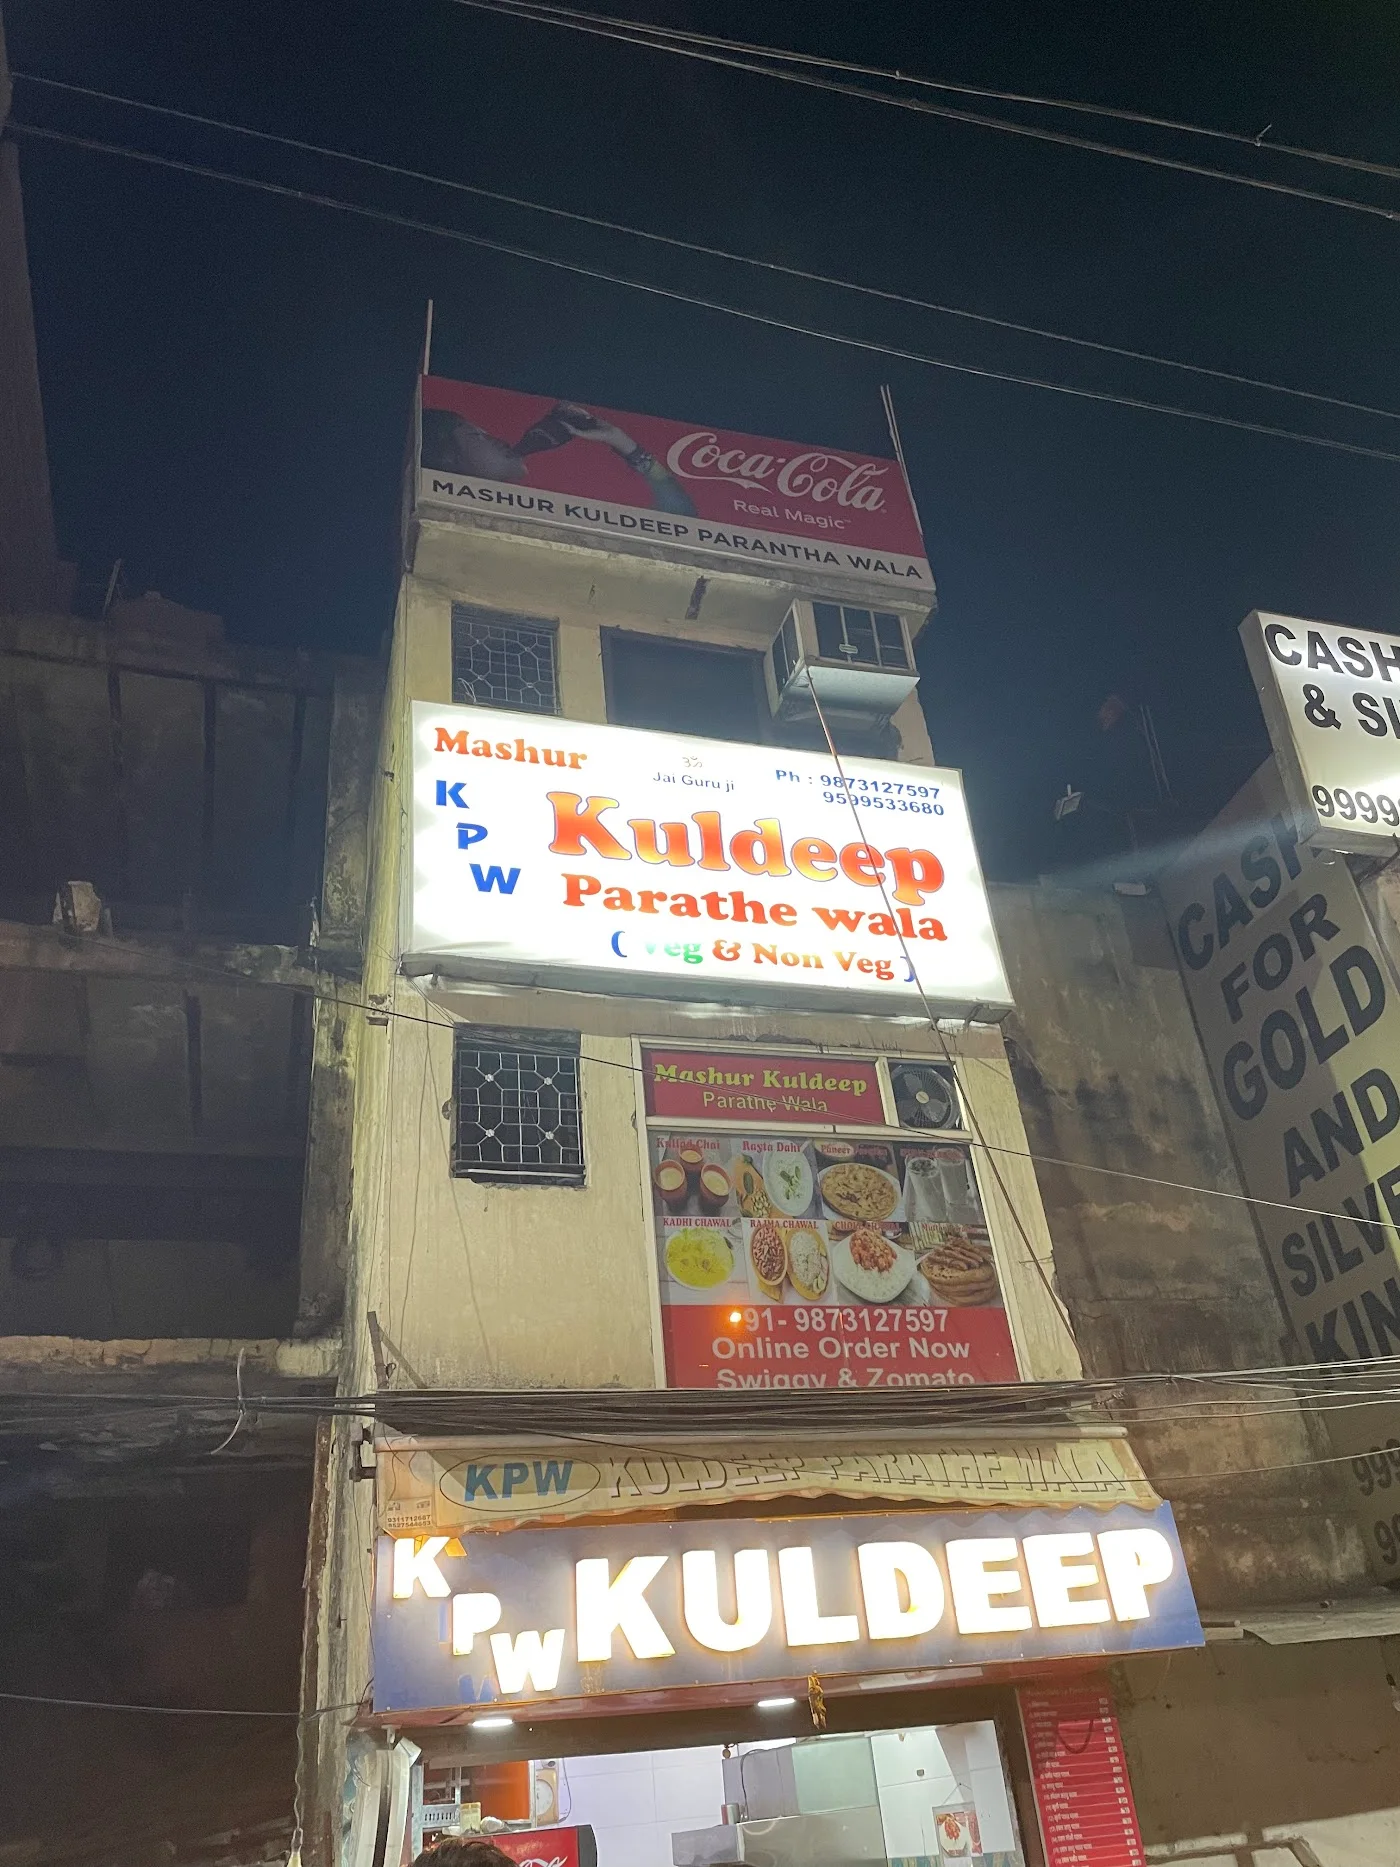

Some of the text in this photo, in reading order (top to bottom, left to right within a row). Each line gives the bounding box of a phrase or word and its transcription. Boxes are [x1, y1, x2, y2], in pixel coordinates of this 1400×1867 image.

[667, 432, 888, 511] Coca-Cola
[433, 479, 923, 580] MASHUR KULDEEP PARANTHA WALA
[733, 500, 845, 529] Real Magic
[1264, 623, 1400, 682] CASH
[1302, 684, 1400, 740] & SI
[434, 727, 587, 770] Mashur
[652, 771, 677, 784] Jai
[681, 775, 721, 790] Guru
[775, 769, 800, 783] Ph
[820, 774, 940, 800] 9873127597
[823, 791, 944, 816] 9599533680
[1312, 785, 1400, 828] 9999
[546, 790, 945, 906] Kuldeep
[561, 872, 948, 942] Parathe wala
[711, 938, 742, 961] &
[752, 942, 824, 970] Non
[832, 951, 895, 981] Veg
[1220, 893, 1340, 1024] FOR
[1223, 945, 1386, 1120] GOLD
[654, 1064, 867, 1096] Mashur Kuldeep
[782, 1095, 828, 1112] Wala
[1284, 1068, 1400, 1198] AND
[663, 1217, 732, 1228] KADHI CHAWAL
[783, 1220, 819, 1230] CHAWAL
[794, 1308, 949, 1332] 9873127597
[712, 1337, 970, 1359] Online Order Now
[838, 1367, 860, 1388] &
[464, 1460, 573, 1502] KPW
[575, 1528, 1174, 1662] KULDEEP
